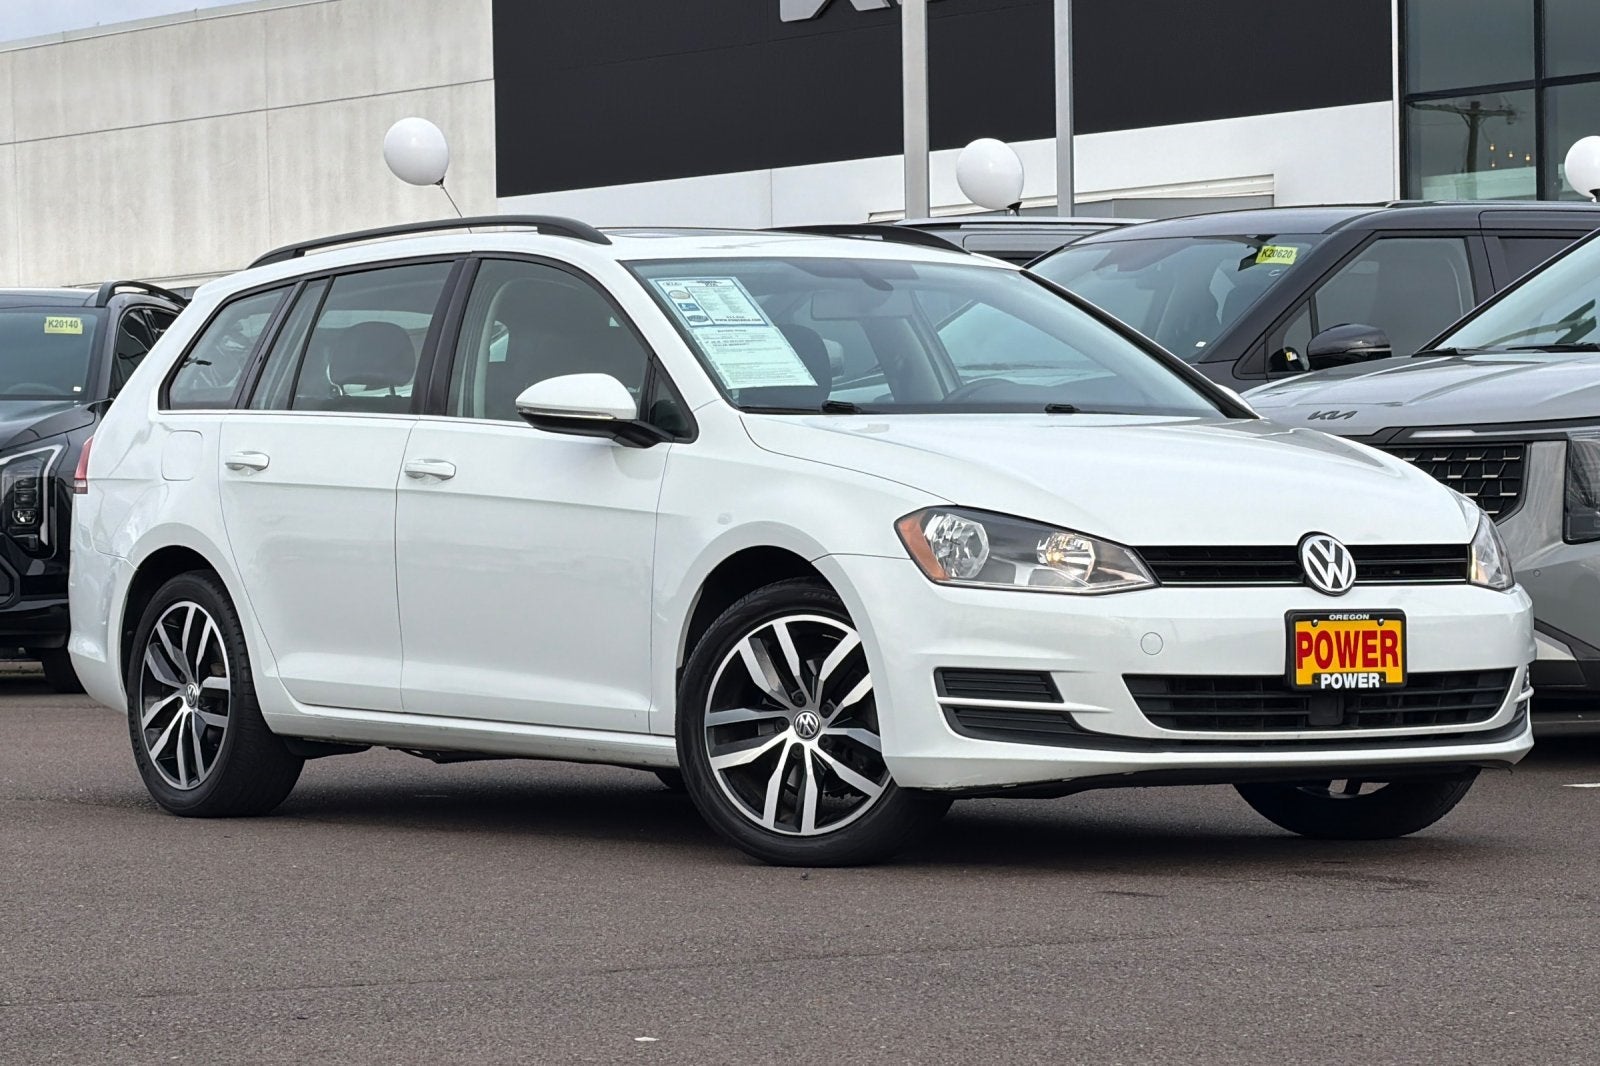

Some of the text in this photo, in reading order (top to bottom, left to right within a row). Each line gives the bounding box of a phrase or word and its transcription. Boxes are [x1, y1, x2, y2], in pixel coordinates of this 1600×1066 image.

[1261, 248, 1294, 259] K20620
[48, 319, 79, 329] K20140
[1296, 629, 1399, 670] POWER
[1320, 672, 1380, 689] POWER
